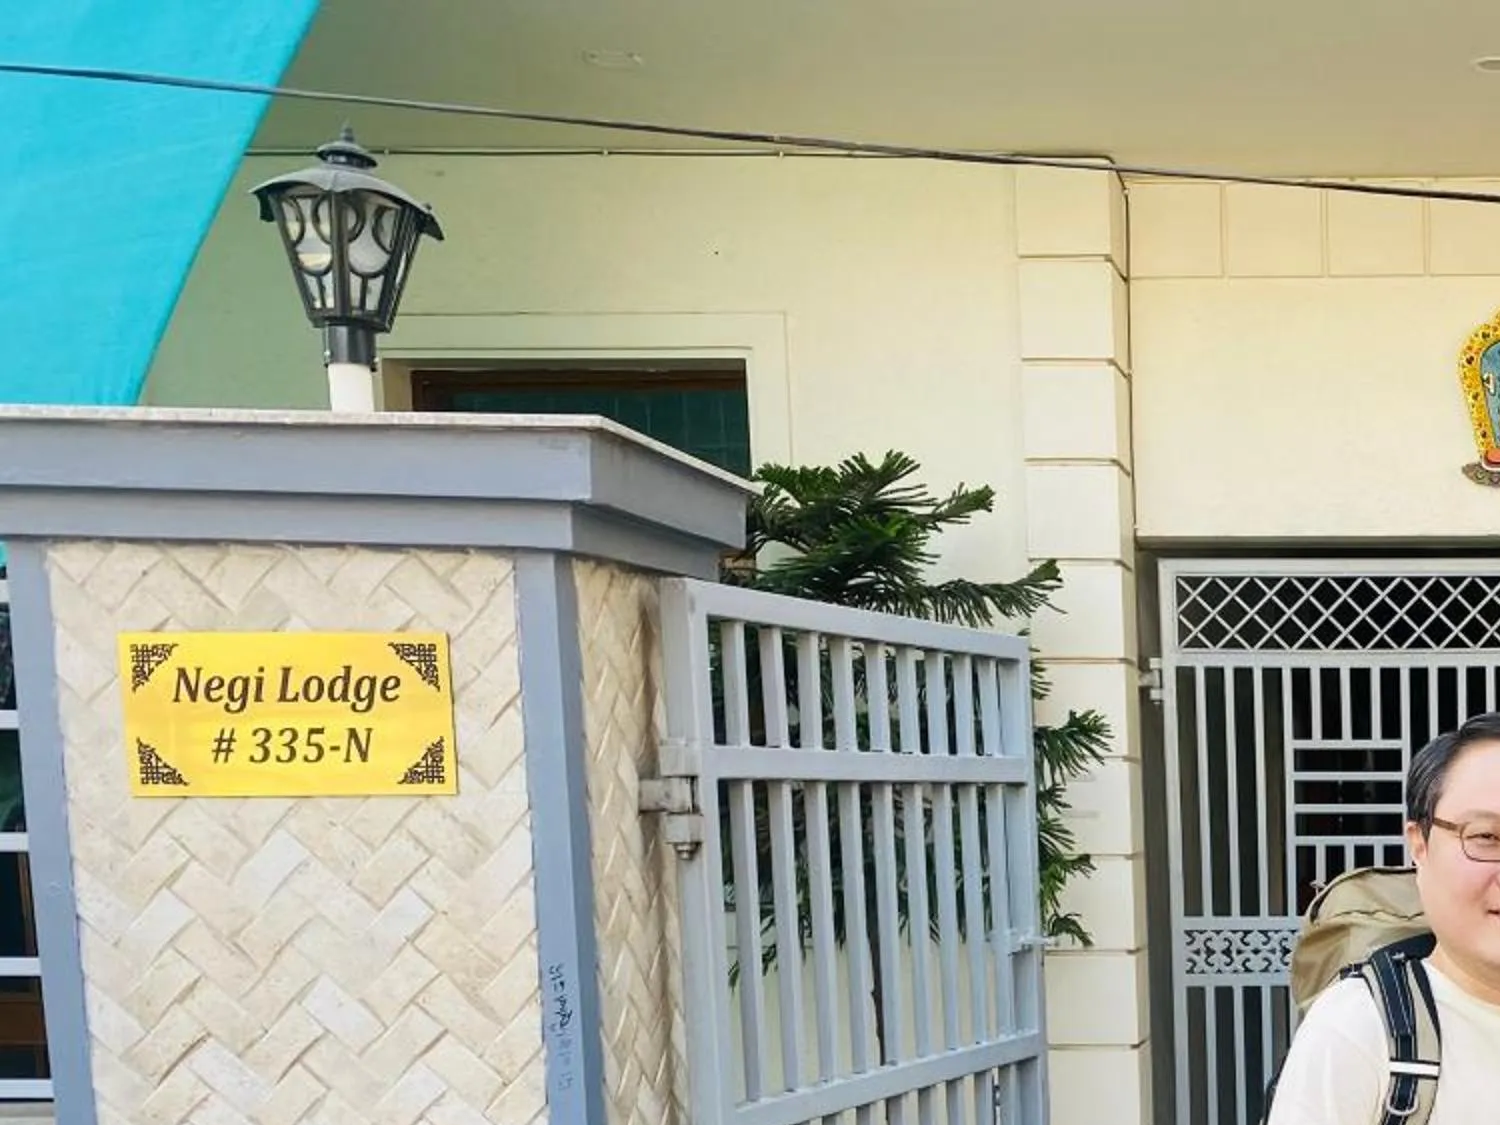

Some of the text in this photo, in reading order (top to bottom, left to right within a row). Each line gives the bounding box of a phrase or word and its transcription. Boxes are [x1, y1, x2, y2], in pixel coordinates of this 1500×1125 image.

[172, 665, 401, 714] Negi Lodge
[211, 727, 374, 764] # 335-N
